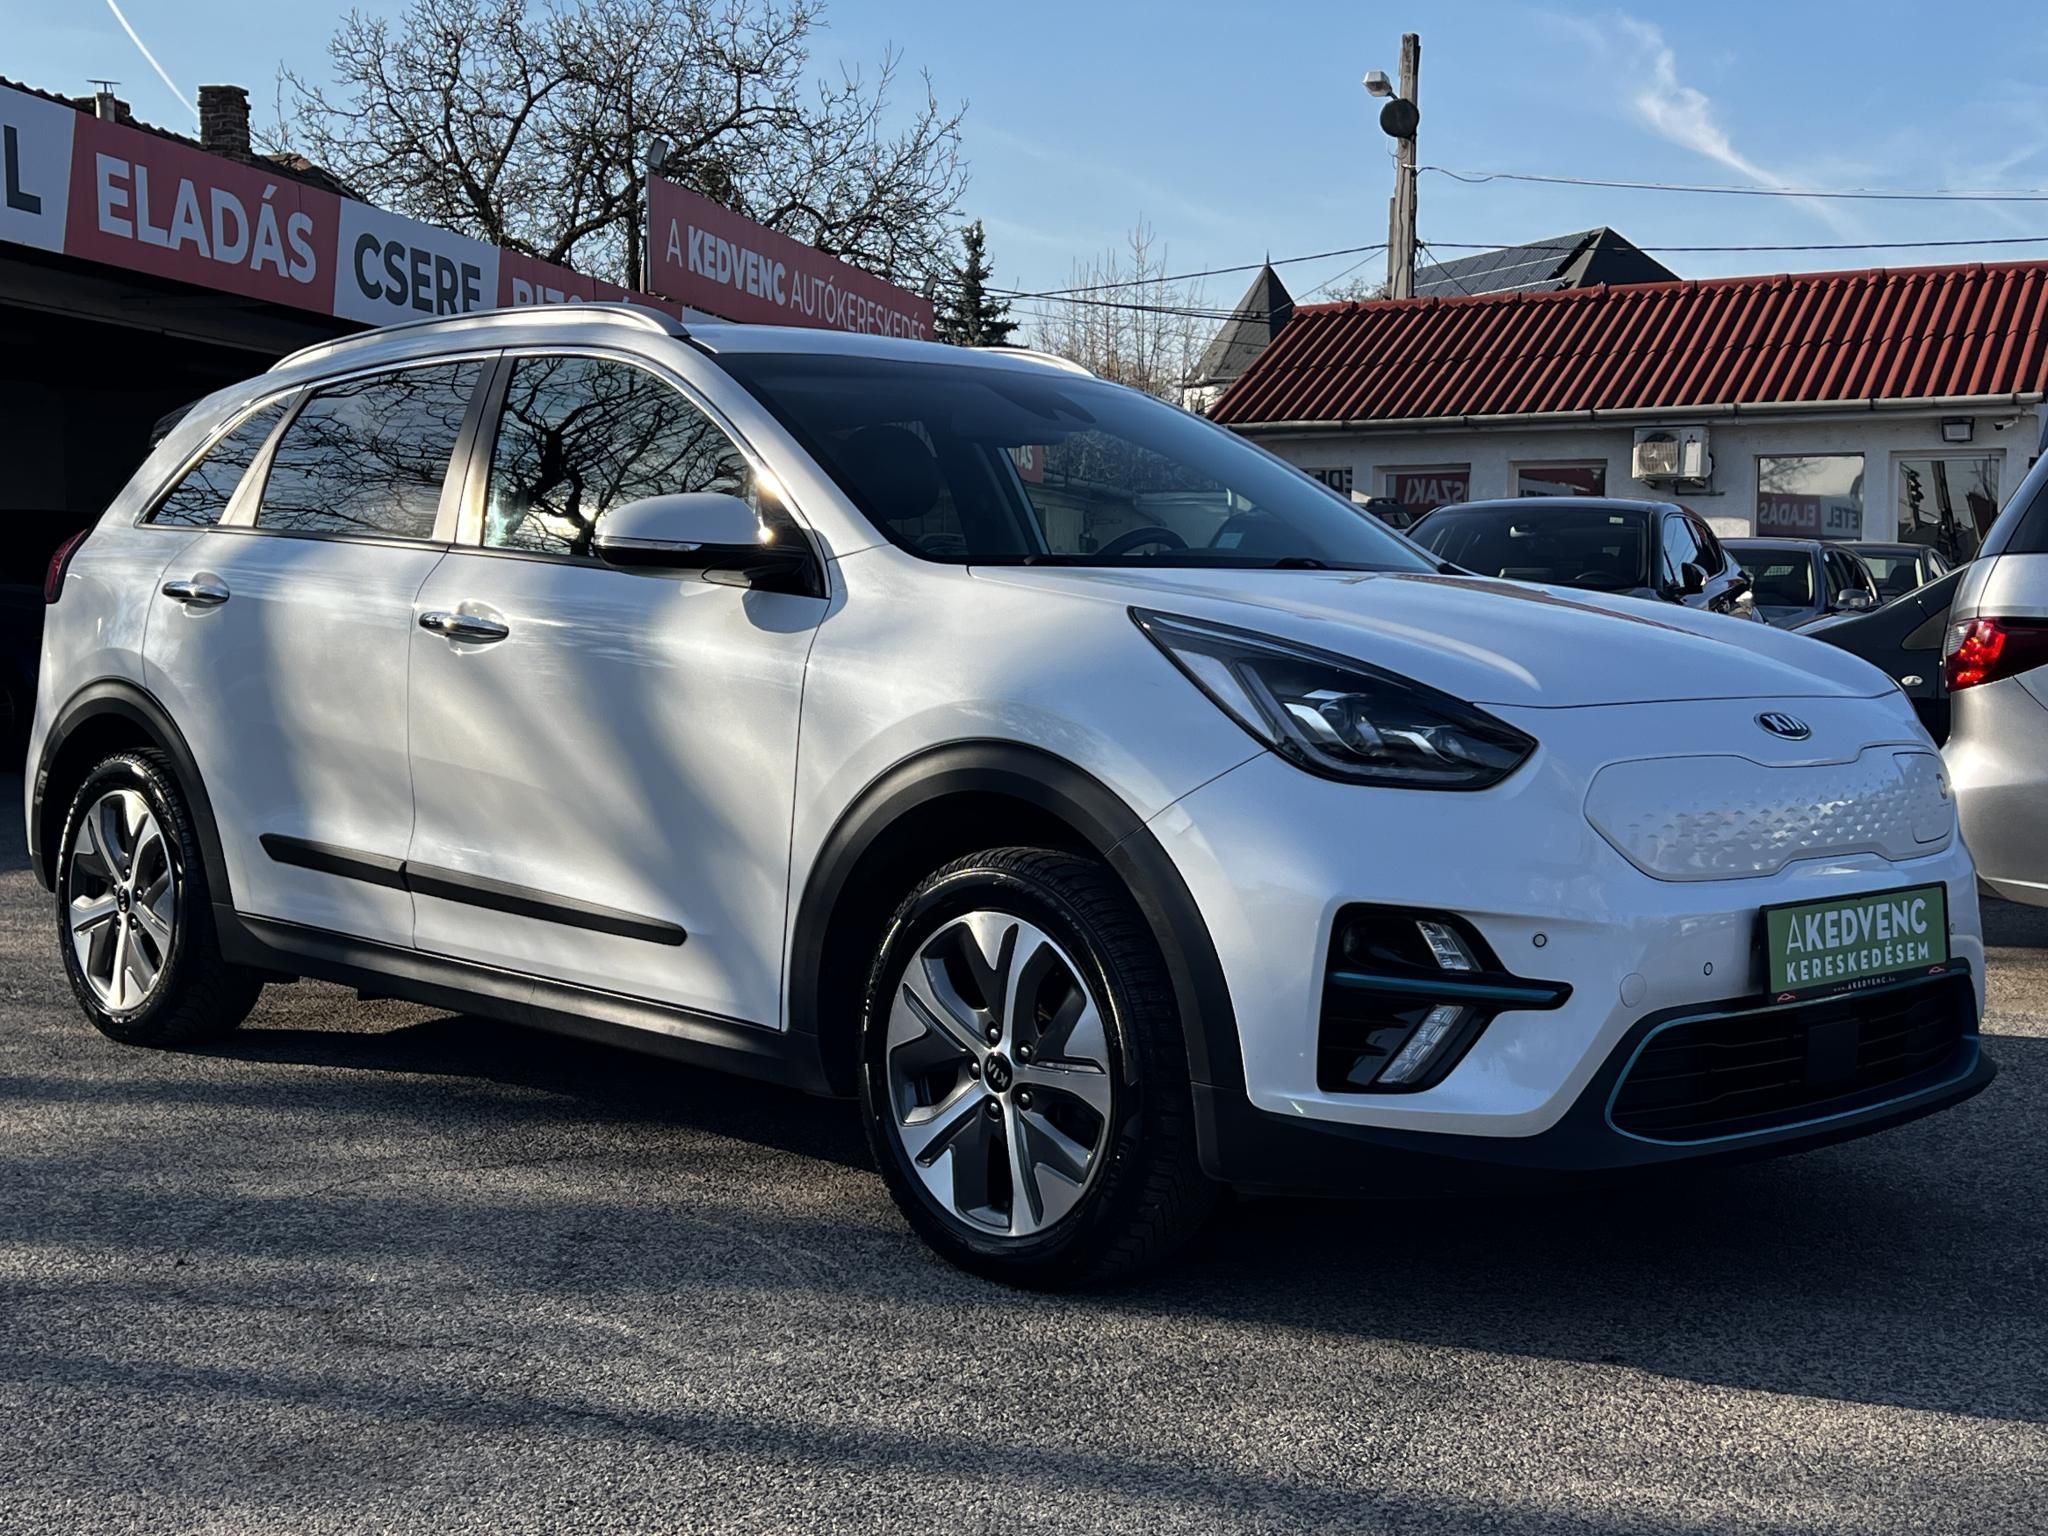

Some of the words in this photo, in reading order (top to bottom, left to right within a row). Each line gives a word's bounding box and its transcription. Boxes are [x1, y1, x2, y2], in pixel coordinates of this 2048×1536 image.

[95, 152, 317, 284] ELADÁS
[354, 233, 481, 316] CSERE
[666, 218, 683, 268] A
[687, 224, 786, 306] KEDVENC
[1786, 940, 1930, 984] KERESKEDÉSEM
